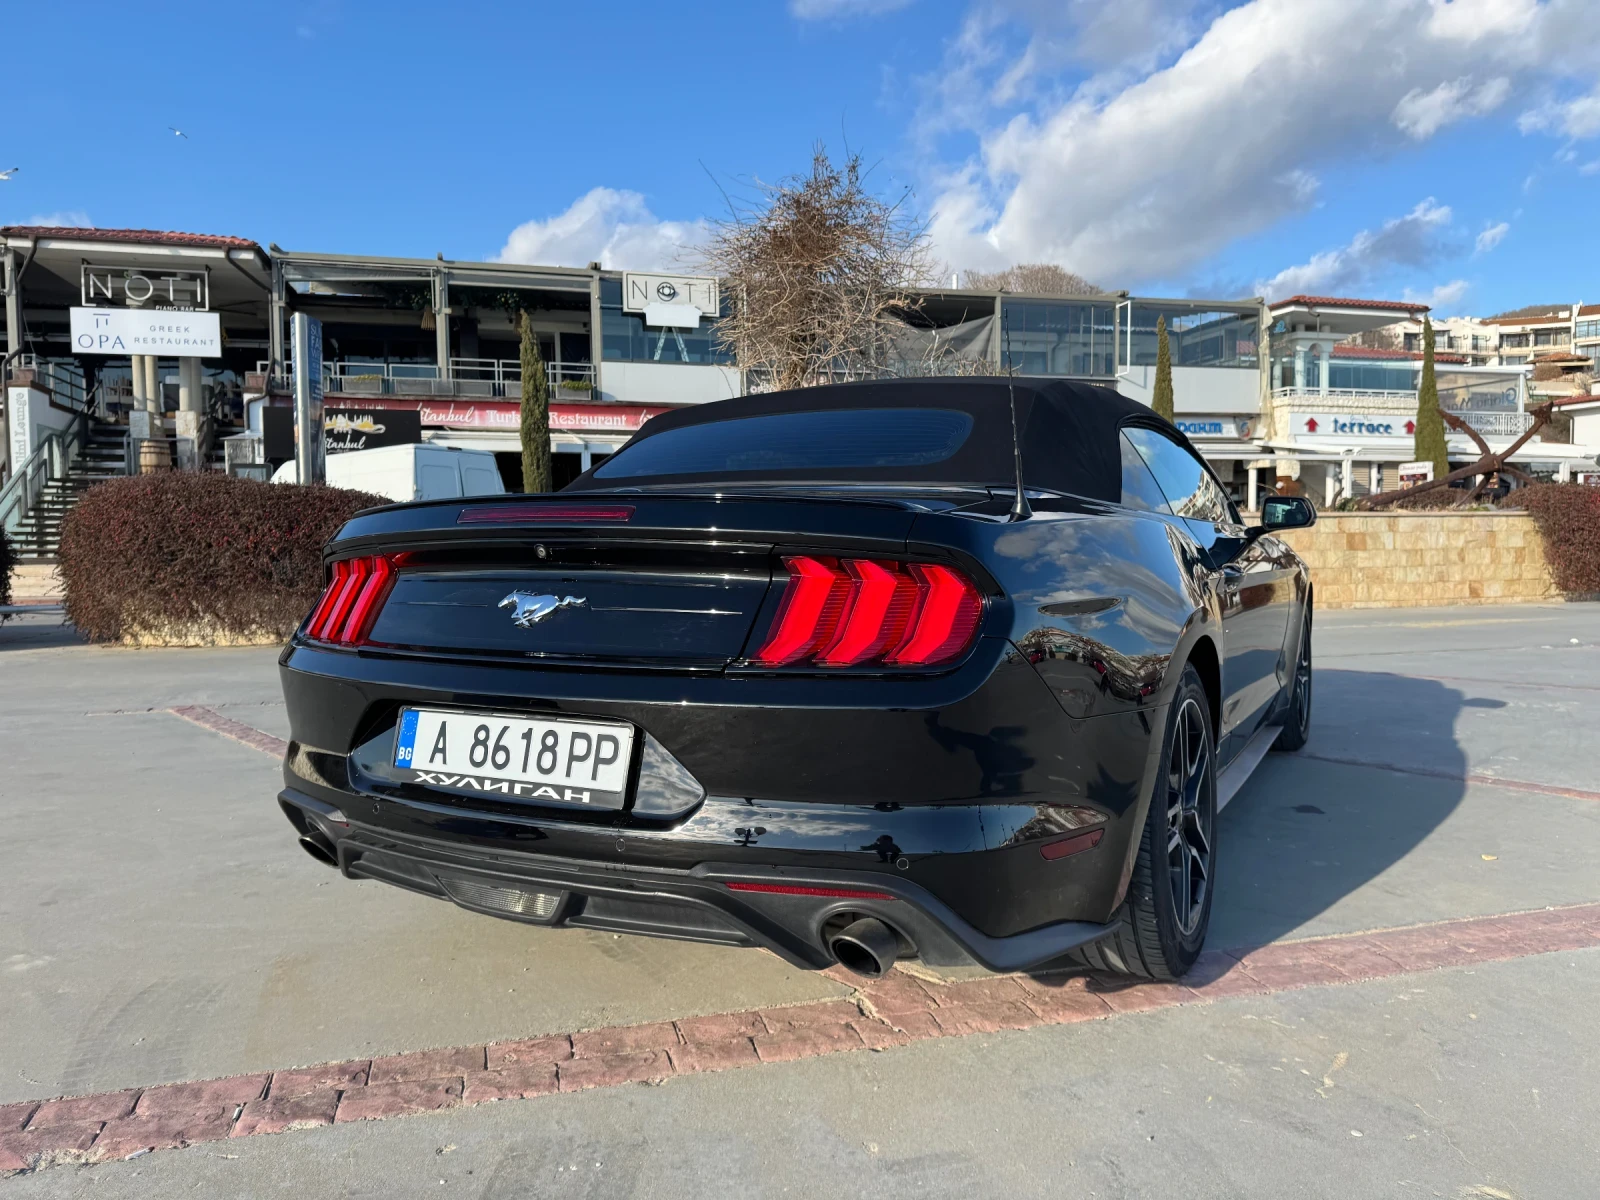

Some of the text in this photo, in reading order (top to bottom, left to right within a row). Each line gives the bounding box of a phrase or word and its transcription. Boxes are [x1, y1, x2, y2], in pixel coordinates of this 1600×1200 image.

[89, 273, 201, 302] NOTI
[149, 325, 190, 333] GREEK
[78, 334, 126, 350] OPA
[134, 337, 215, 346] RESTAURANT
[486, 409, 521, 424] Turk
[549, 411, 627, 426] Restaurant
[1333, 417, 1393, 434] terrace
[397, 746, 413, 761] BG
[414, 771, 591, 803] ХУЛИГАН
